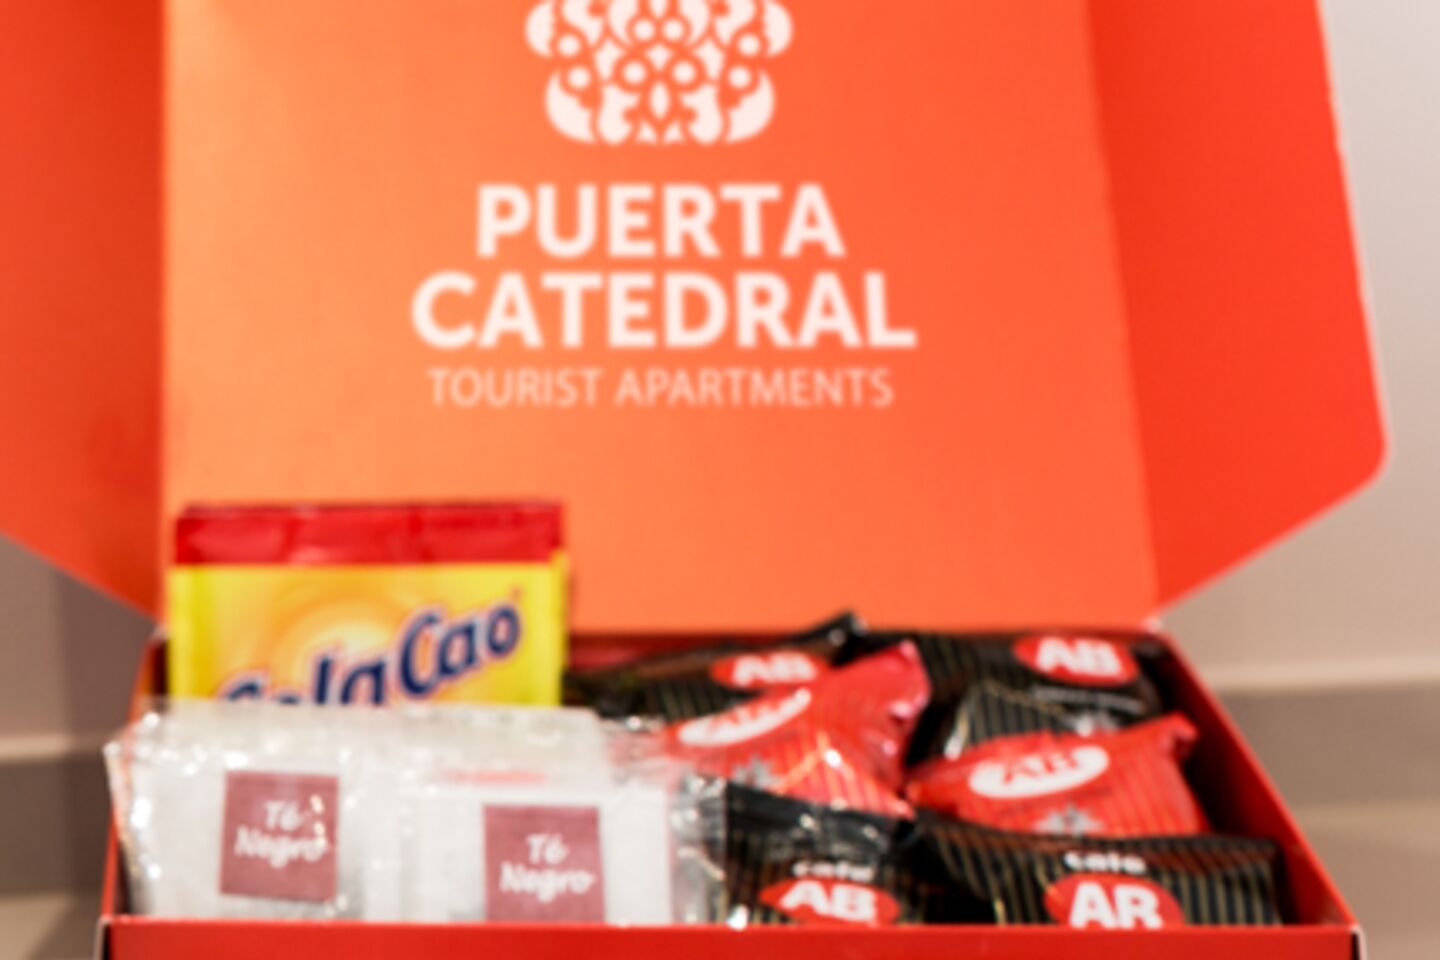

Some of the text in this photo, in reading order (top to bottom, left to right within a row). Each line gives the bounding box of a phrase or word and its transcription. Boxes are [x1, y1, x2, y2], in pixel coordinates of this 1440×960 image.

[476, 183, 846, 258] PUERTA
[411, 271, 917, 348] CATEDRAL
[426, 367, 894, 407] TOURIST APARTMENTS
[233, 826, 328, 869] Negro
[525, 833, 570, 865] Té
[499, 860, 596, 903] Negro
[780, 880, 878, 924] AB
